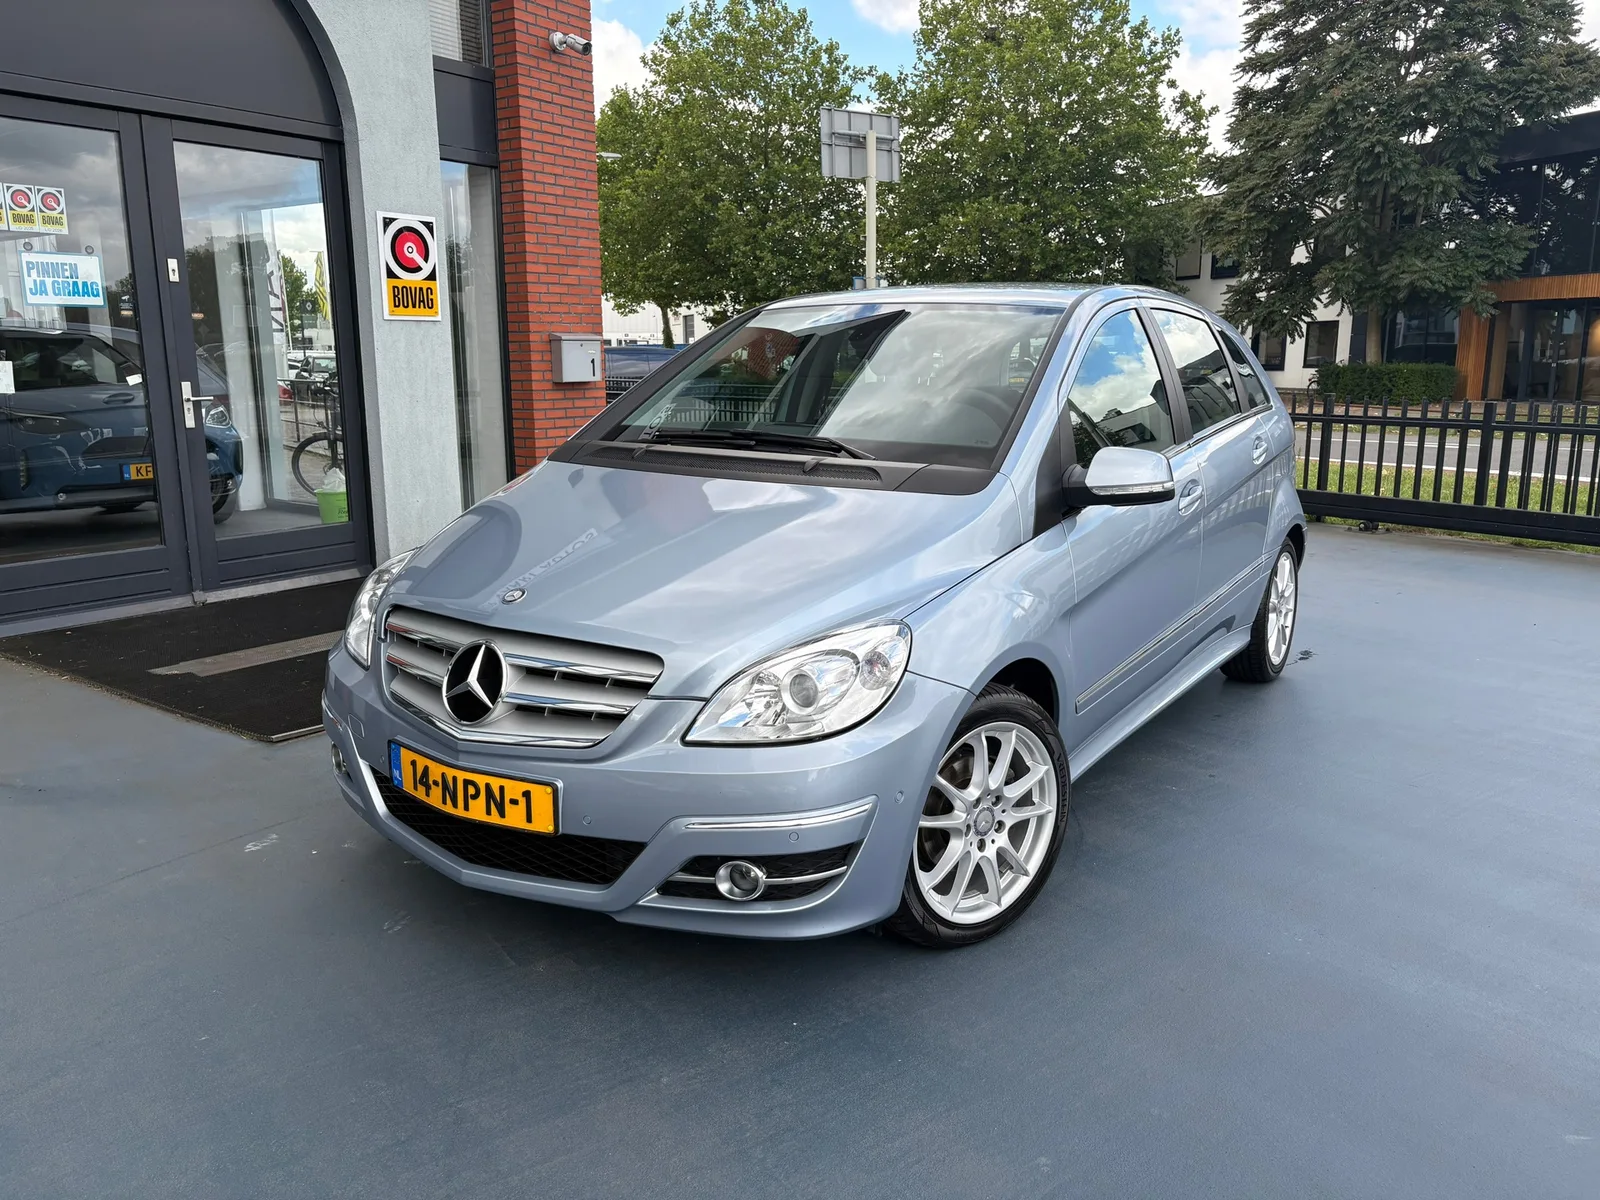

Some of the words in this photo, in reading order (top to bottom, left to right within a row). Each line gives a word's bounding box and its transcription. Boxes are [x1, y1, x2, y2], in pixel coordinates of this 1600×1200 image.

[12, 212, 35, 224] BOVAG
[41, 215, 64, 227] BOVAG
[25, 261, 79, 279] PINNEN
[29, 280, 49, 297] JA
[51, 280, 100, 298] GRAAG
[392, 285, 434, 309] BOVAG
[590, 358, 596, 378] 1
[393, 768, 402, 781] NL
[410, 759, 533, 824] 14-NPN-1
